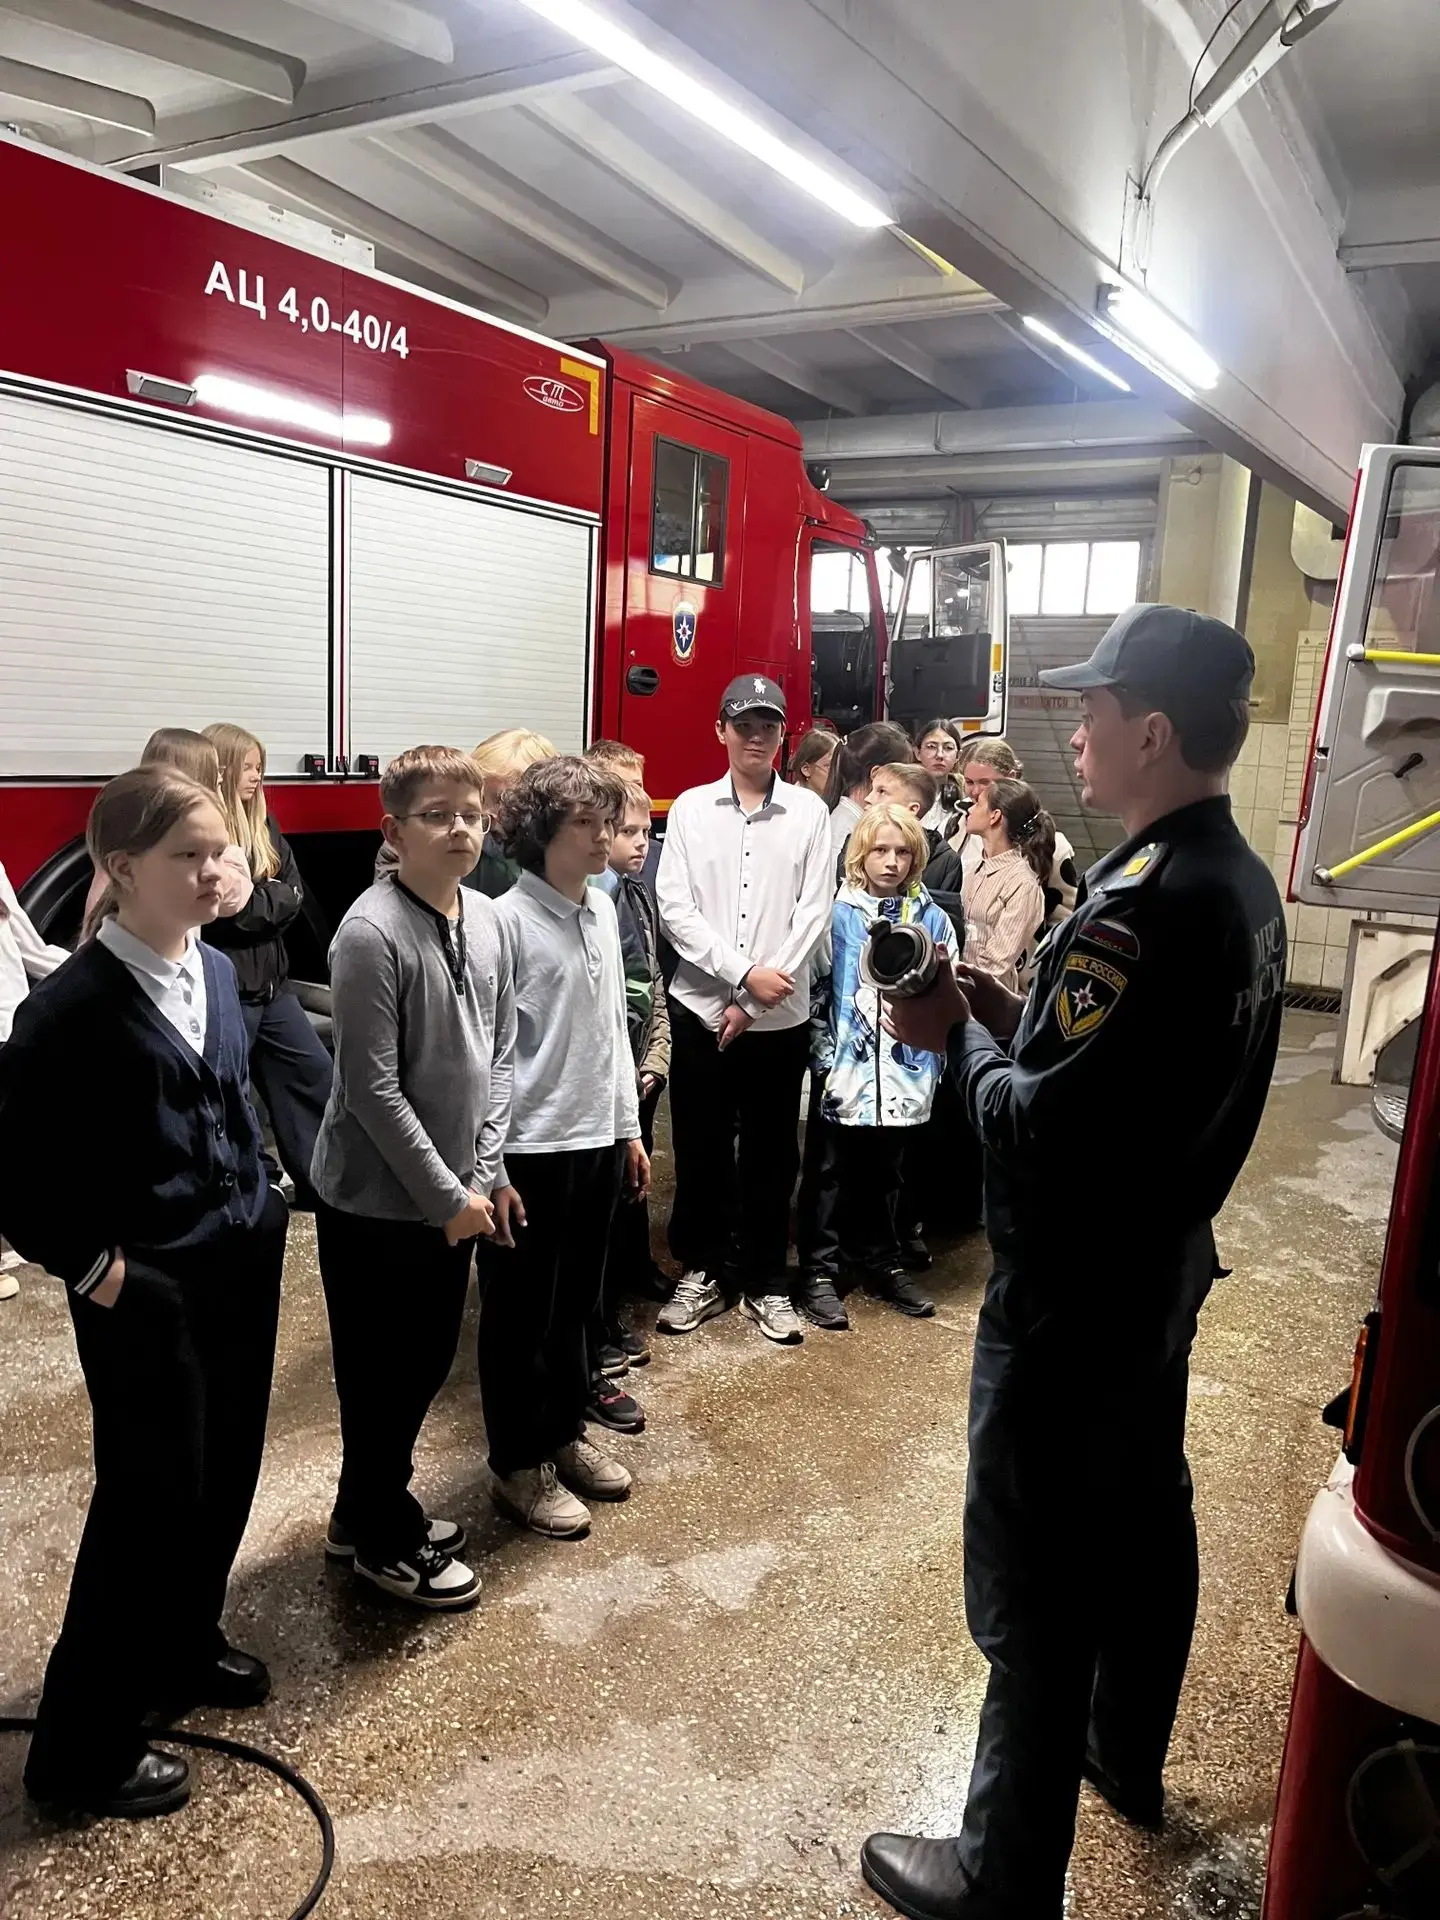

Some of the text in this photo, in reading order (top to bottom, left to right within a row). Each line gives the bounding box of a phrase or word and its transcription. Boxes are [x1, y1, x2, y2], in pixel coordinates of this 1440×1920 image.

[204, 260, 409, 359] АЦ 4,0-40/4
[1089, 961, 1126, 990] РОССИИ
